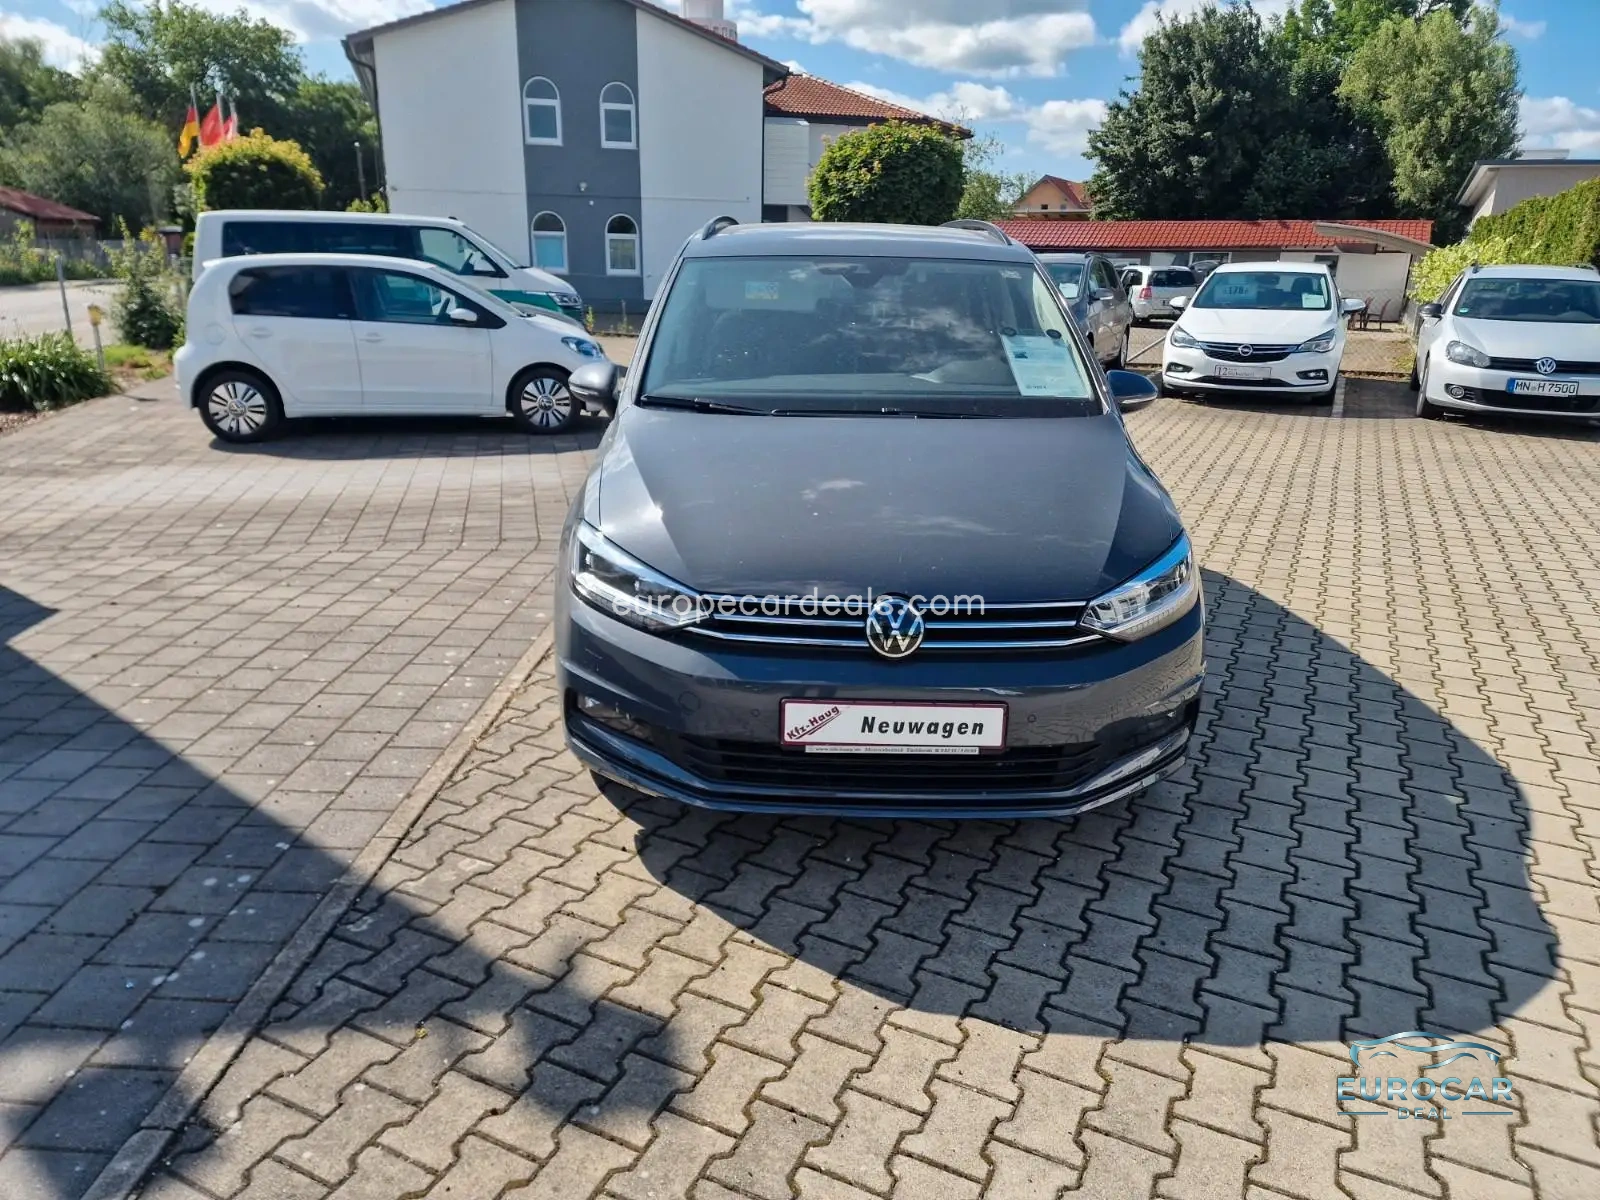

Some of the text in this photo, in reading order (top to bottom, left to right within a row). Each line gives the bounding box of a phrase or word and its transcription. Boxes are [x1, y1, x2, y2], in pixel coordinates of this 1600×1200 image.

[1515, 381, 1577, 394] MN H 7500
[860, 716, 984, 739] Neuwagen
